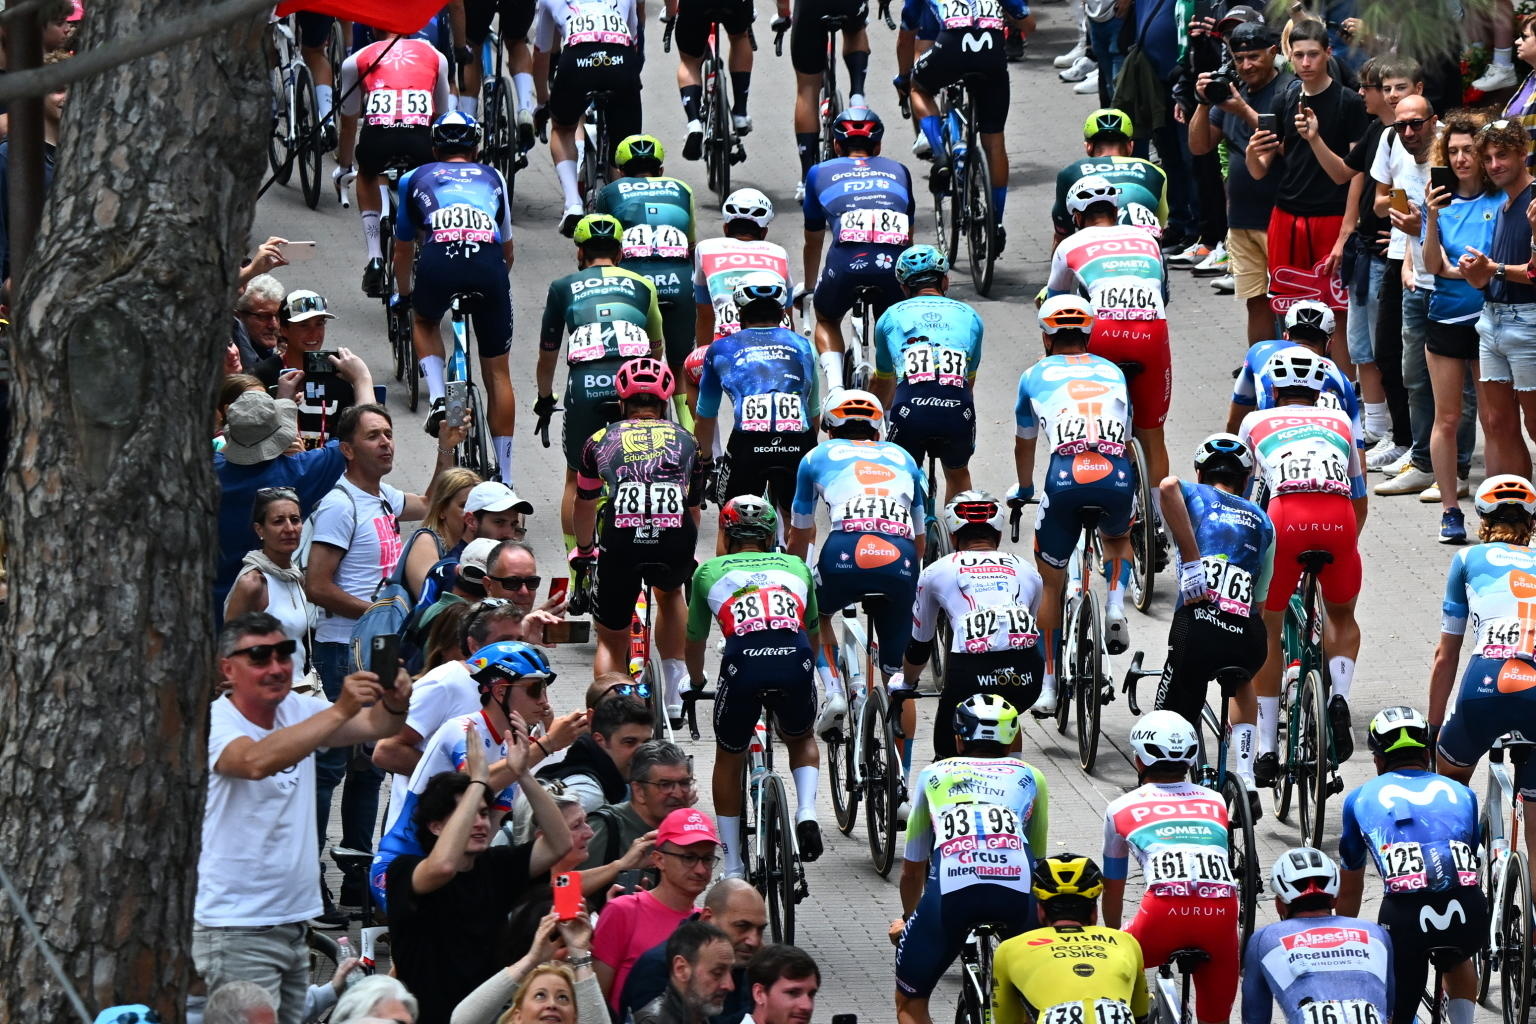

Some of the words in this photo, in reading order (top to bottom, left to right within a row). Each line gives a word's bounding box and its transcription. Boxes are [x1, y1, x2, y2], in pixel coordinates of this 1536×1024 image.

[569, 19, 595, 34] 195
[602, 16, 627, 31] 195
[371, 94, 391, 114] 53
[406, 93, 426, 113] 53
[832, 169, 896, 182] Groupama
[1081, 162, 1146, 174] BORA
[618, 181, 678, 193] BORA
[844, 181, 874, 191] FDJ
[432, 207, 462, 231] 103
[464, 209, 493, 231] 103
[845, 215, 865, 229] 84
[880, 215, 900, 232] 84
[435, 230, 463, 242] enel
[627, 228, 646, 246] 41
[663, 227, 682, 246] 41
[1086, 240, 1157, 255] POLTI
[714, 254, 779, 270] POLTI
[1102, 260, 1150, 269] KOMETA
[570, 278, 634, 294] BORA
[1100, 288, 1128, 308] 164
[1102, 331, 1151, 339] AURUM
[907, 349, 928, 372] 37
[943, 349, 963, 376] 37
[746, 397, 768, 419] 65
[779, 397, 800, 419] 65
[911, 397, 961, 408] Wilier
[1057, 418, 1087, 445] 142
[1269, 416, 1339, 431] POLTI
[1098, 420, 1125, 444] 142
[624, 449, 667, 462] Education
[1058, 442, 1088, 454] enel
[1076, 459, 1109, 472] postnl
[1280, 459, 1311, 483] 167
[618, 486, 639, 514] 78
[654, 487, 677, 513] 78
[842, 496, 877, 519] 147
[615, 516, 645, 528] enel
[652, 514, 682, 527] enel
[844, 519, 878, 531] enel
[1287, 523, 1344, 532] AURUM
[859, 543, 896, 557] postnl
[721, 555, 785, 567] ASTANA
[961, 557, 1013, 567] UAE
[1229, 572, 1251, 603] 63
[735, 596, 759, 622] 38
[772, 594, 796, 615] 38
[966, 610, 996, 639] 192
[1193, 609, 1244, 634] DECATHLON
[1485, 624, 1519, 645] 146
[743, 646, 797, 657] Wilier
[1503, 668, 1536, 681] postnl
[948, 784, 1006, 797] FANTINI
[1132, 803, 1220, 821] POLTI
[944, 809, 970, 839] 93
[989, 808, 1013, 834] 93
[1156, 826, 1212, 836] KOMETA
[942, 838, 977, 856] enel
[987, 835, 1021, 849] enel
[1151, 852, 1188, 880] 161
[1199, 854, 1232, 881] 161
[1386, 848, 1423, 877] 125
[1429, 848, 1443, 880] CANYON
[1155, 881, 1190, 895] enel
[1199, 882, 1232, 898] enel
[1389, 874, 1428, 891] enel
[1168, 906, 1225, 916] AURUM
[1060, 935, 1118, 945] VISMA
[1292, 929, 1360, 946] Alpecin
[1288, 948, 1370, 963] deceuninck
